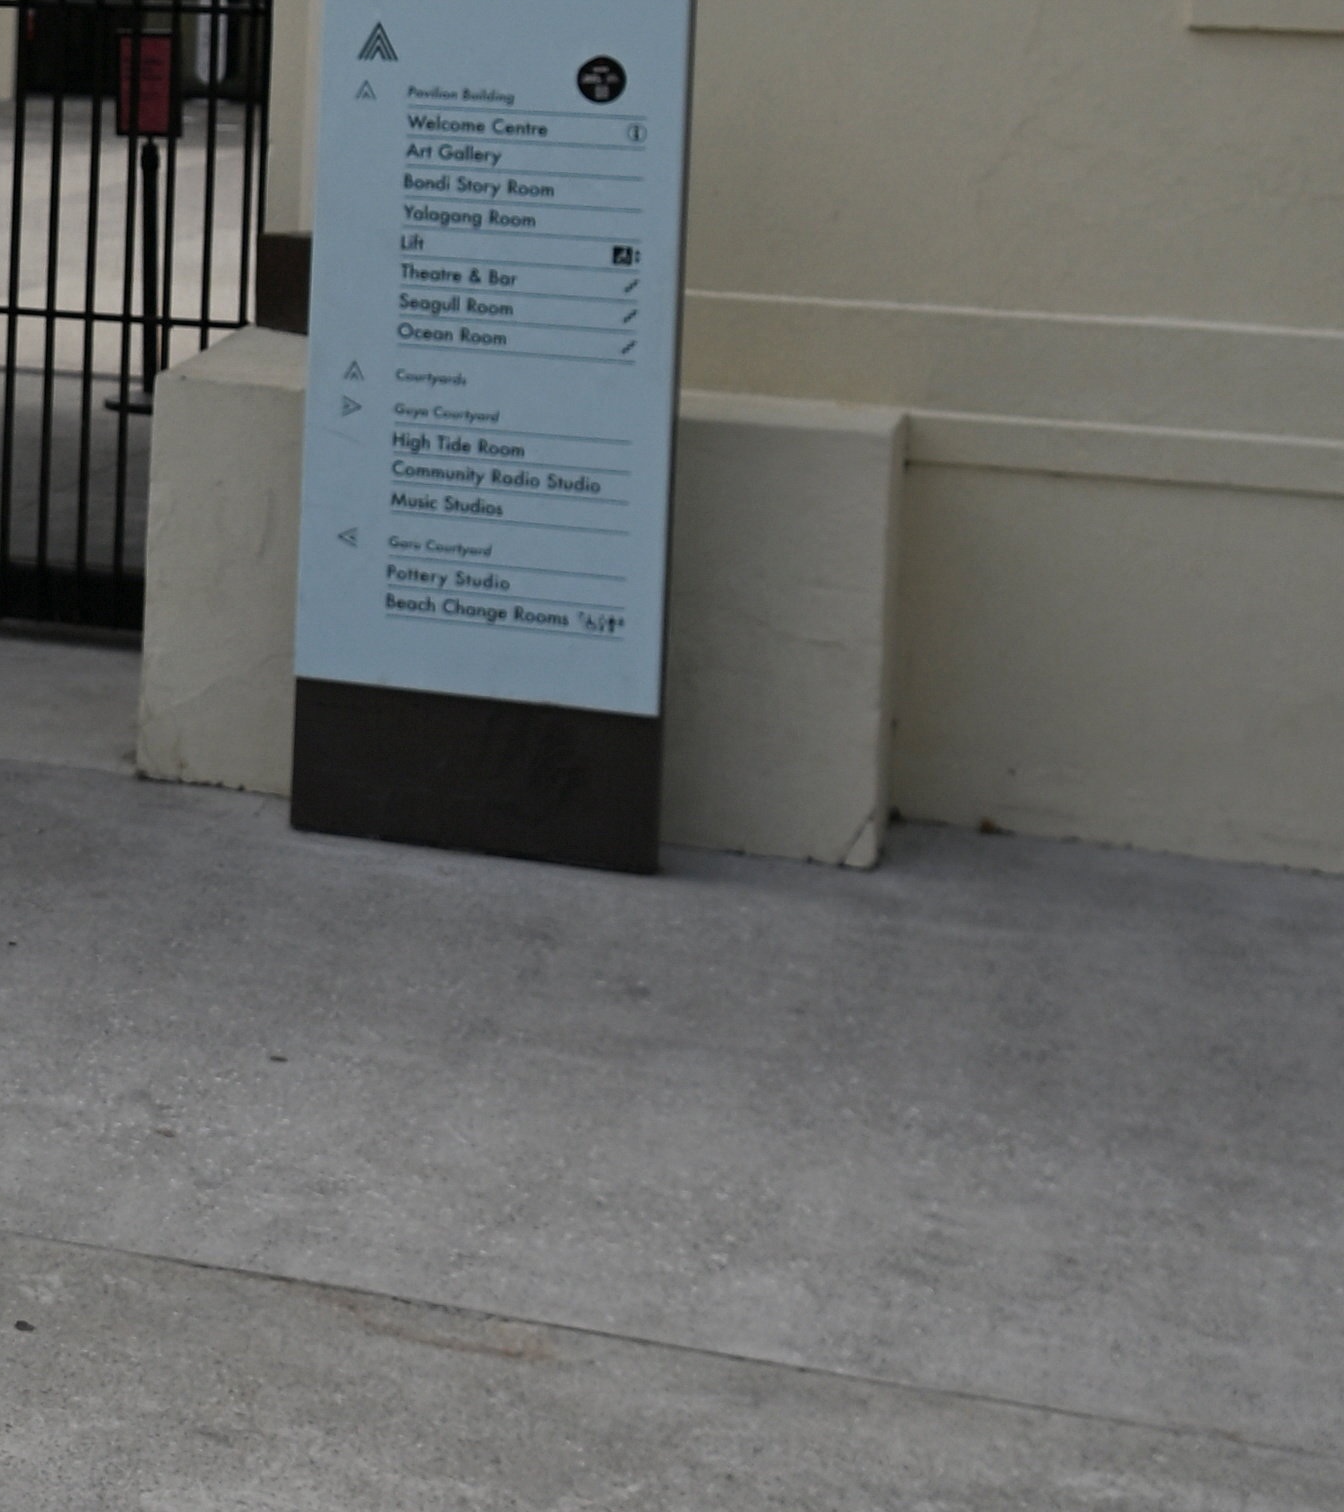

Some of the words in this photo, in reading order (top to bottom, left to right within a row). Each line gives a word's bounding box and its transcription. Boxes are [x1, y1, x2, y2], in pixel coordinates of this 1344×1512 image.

[408, 86, 457, 100] Pavilion
[463, 88, 515, 106] Building
[408, 114, 486, 133] Welcome
[492, 118, 548, 137] Centre
[406, 143, 432, 159] Art
[438, 144, 502, 166] Gallery
[404, 172, 450, 190] Bondi
[457, 175, 501, 198] Story
[507, 179, 555, 197] Room
[404, 204, 483, 227] Yalagang
[488, 208, 536, 227] Room
[400, 234, 424, 251] Lift
[401, 263, 463, 284] Theatre
[468, 268, 482, 284] &
[488, 269, 517, 287] Bar
[399, 293, 460, 317] Seagull
[469, 298, 514, 316] Room
[397, 322, 454, 343] Ocean
[460, 327, 507, 346] Room
[395, 368, 466, 387] Courtyards
[433, 406, 500, 423] Courtyard
[393, 432, 430, 454] High
[438, 435, 471, 453] Tide
[478, 439, 525, 457] Room
[392, 460, 484, 486] Community
[492, 469, 540, 488] Radio
[548, 473, 601, 493] Studio
[391, 493, 438, 510] Music
[445, 496, 503, 516] Studios
[426, 539, 493, 557] Courtyard
[386, 565, 448, 588] Pottery
[456, 570, 510, 591] Studio
[385, 593, 436, 612] Beach
[443, 599, 507, 624] Change
[514, 606, 570, 626] Rooms
